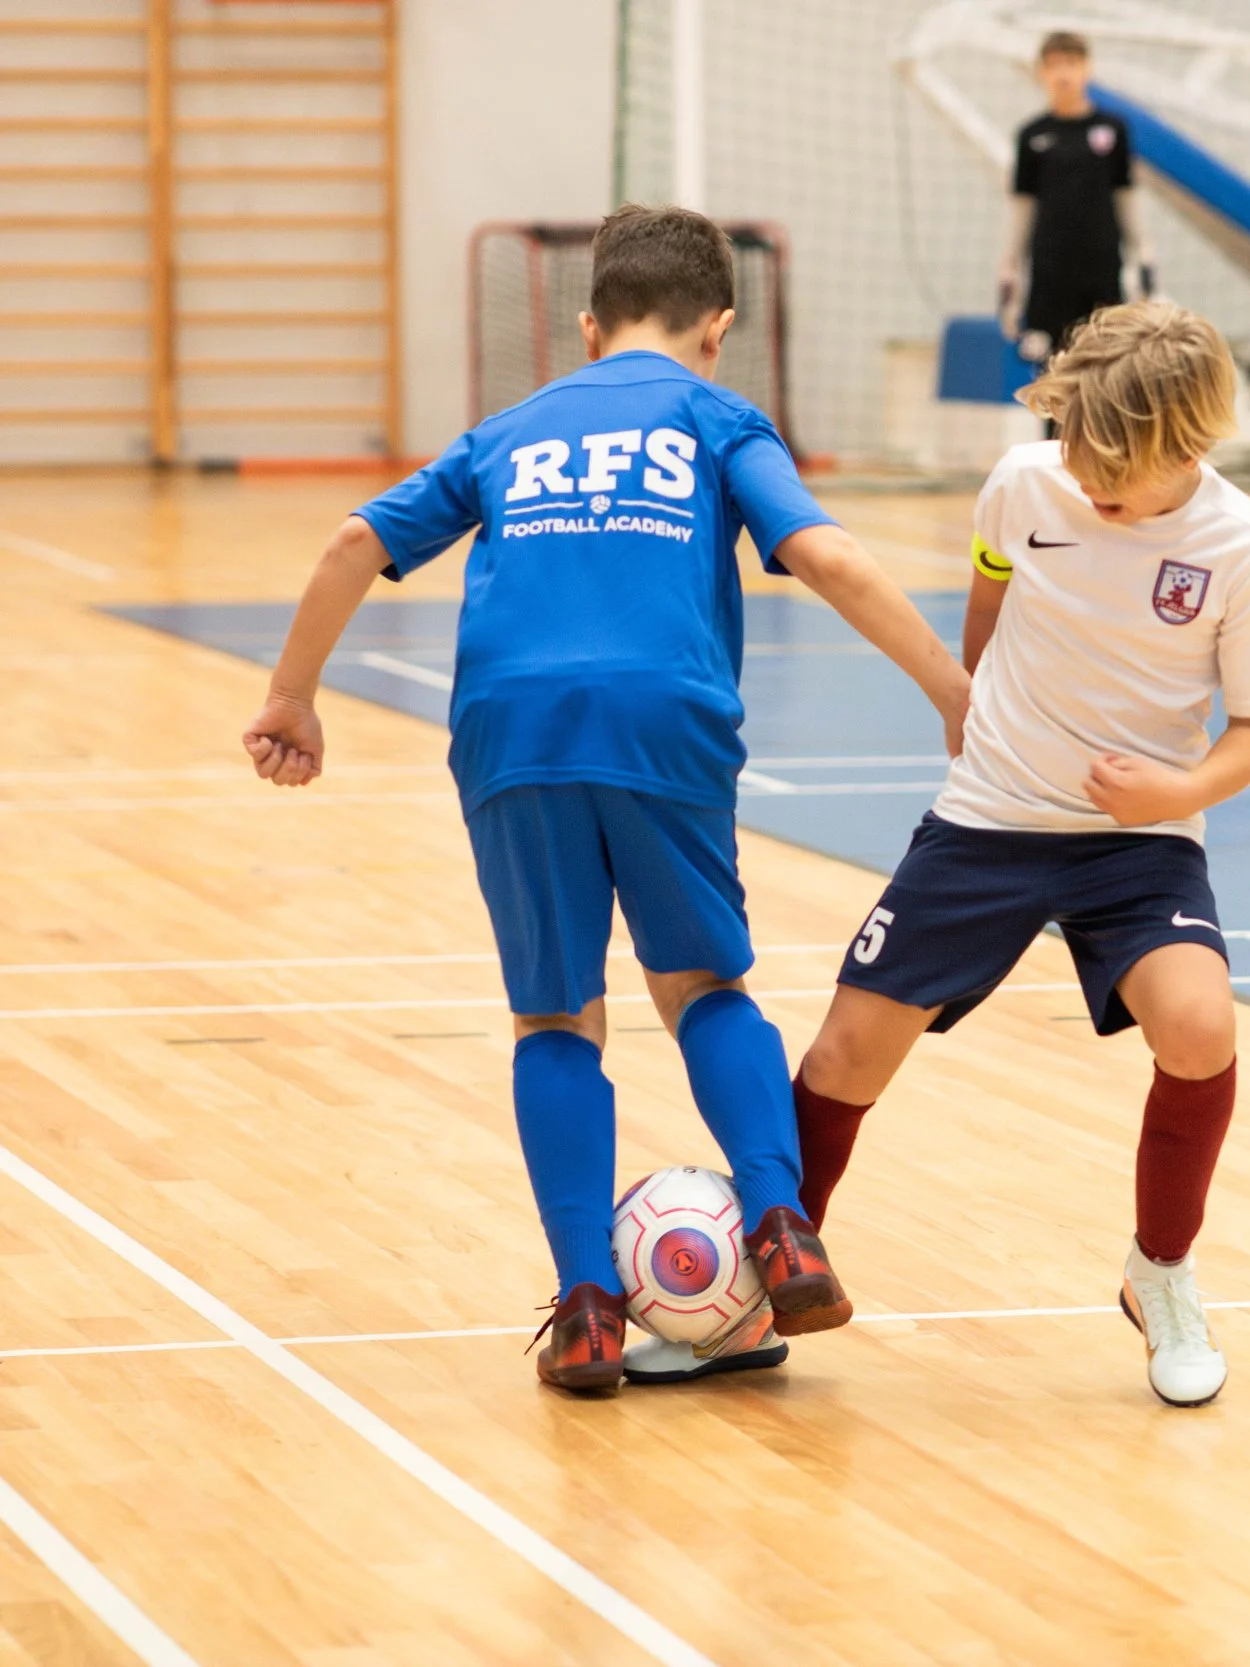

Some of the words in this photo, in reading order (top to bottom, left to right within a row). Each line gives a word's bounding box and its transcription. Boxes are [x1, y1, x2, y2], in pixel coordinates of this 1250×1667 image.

[505, 428, 697, 502] RFS
[502, 516, 600, 539] FOOTBALL
[604, 515, 695, 544] ACADEMY
[853, 906, 895, 964] 5
